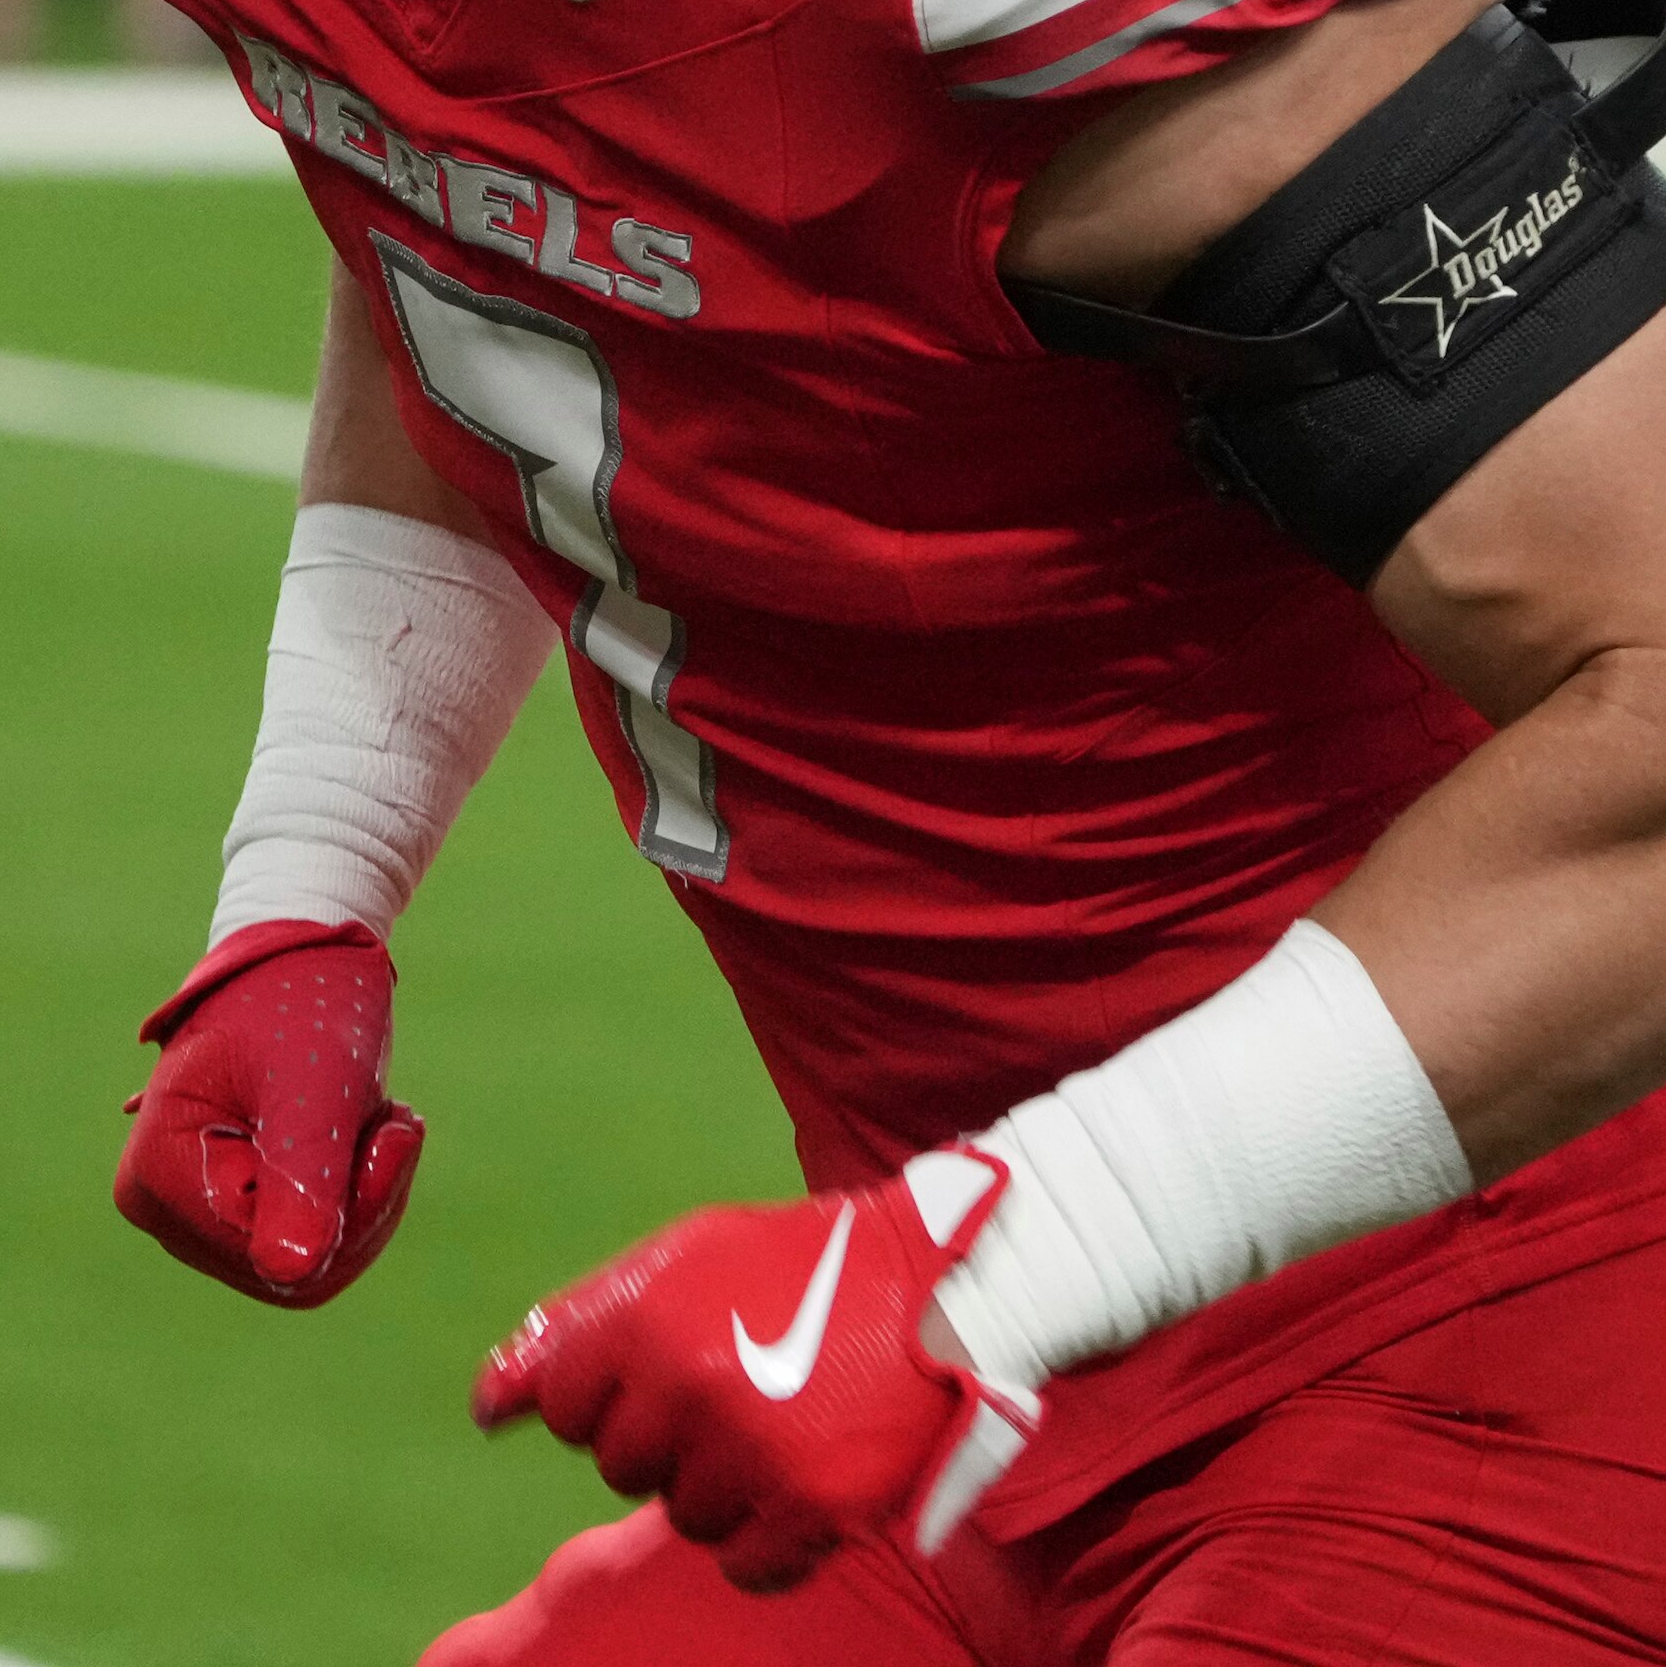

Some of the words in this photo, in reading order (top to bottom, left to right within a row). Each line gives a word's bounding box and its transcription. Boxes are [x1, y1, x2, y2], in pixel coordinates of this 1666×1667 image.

[234, 30, 701, 320] REBELS
[1443, 172, 1584, 300] Douglas
[368, 226, 731, 883] 7
